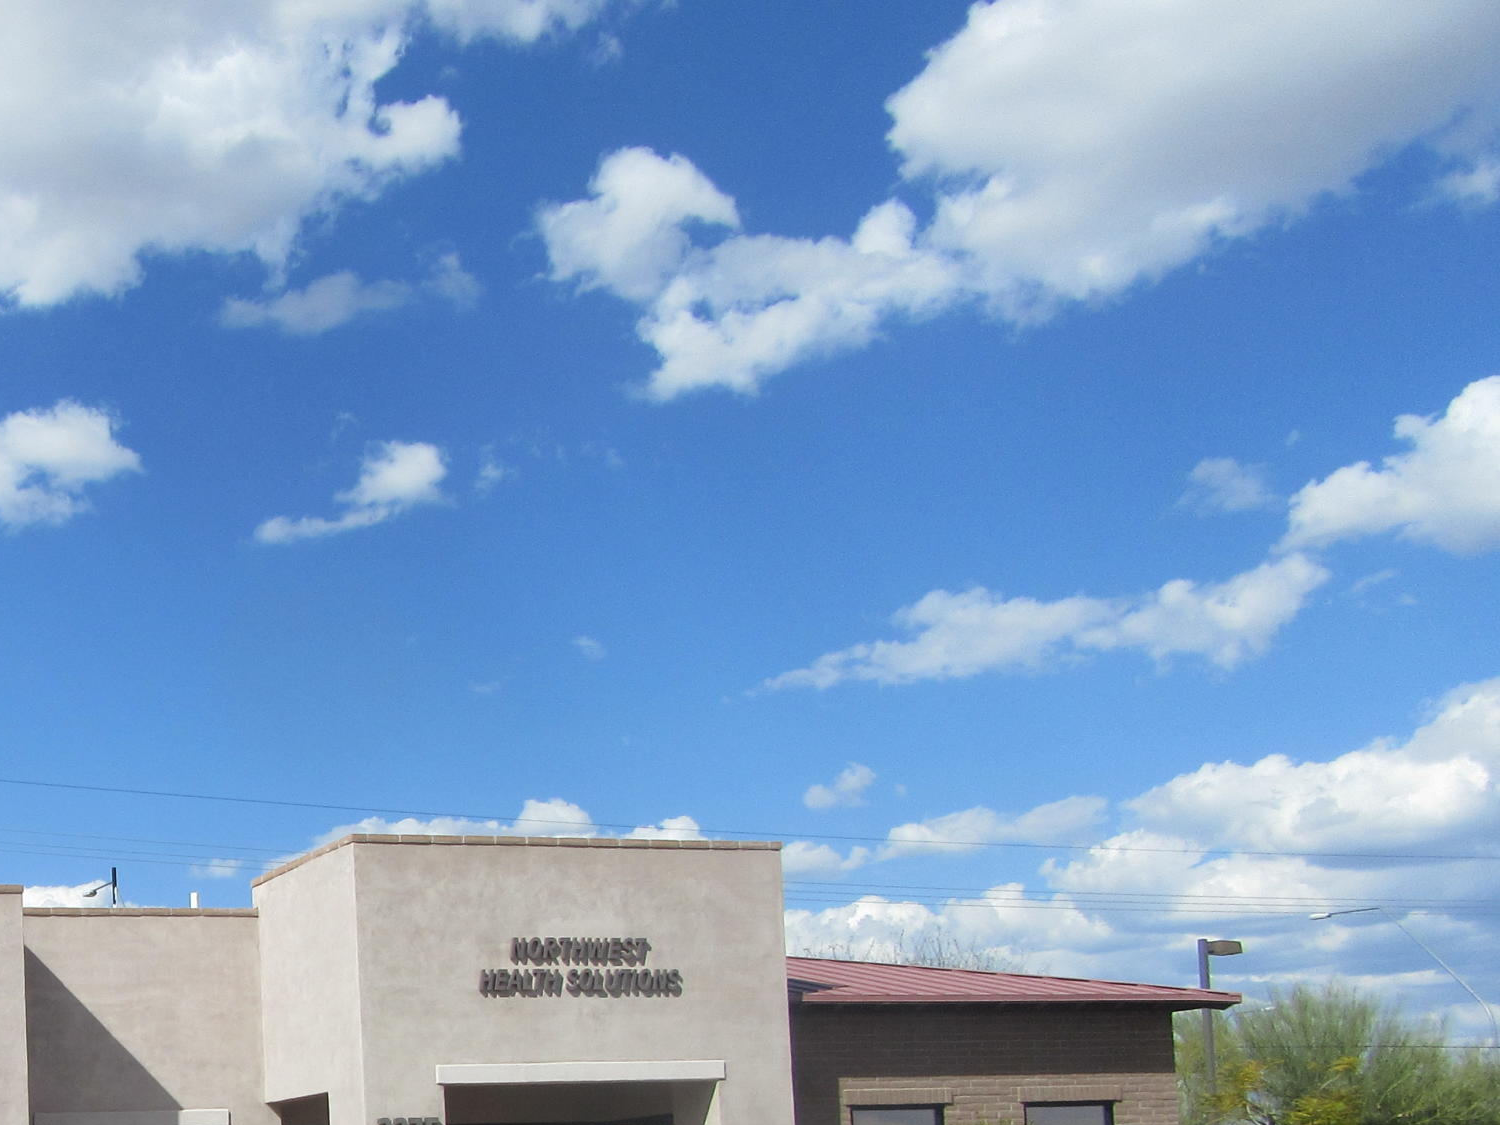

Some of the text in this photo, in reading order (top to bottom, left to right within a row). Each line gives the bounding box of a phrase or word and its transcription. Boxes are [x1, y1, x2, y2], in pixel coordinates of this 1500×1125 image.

[510, 937, 651, 966] NORTHWEST
[480, 968, 683, 998] HEALTH SOLUTIONS
